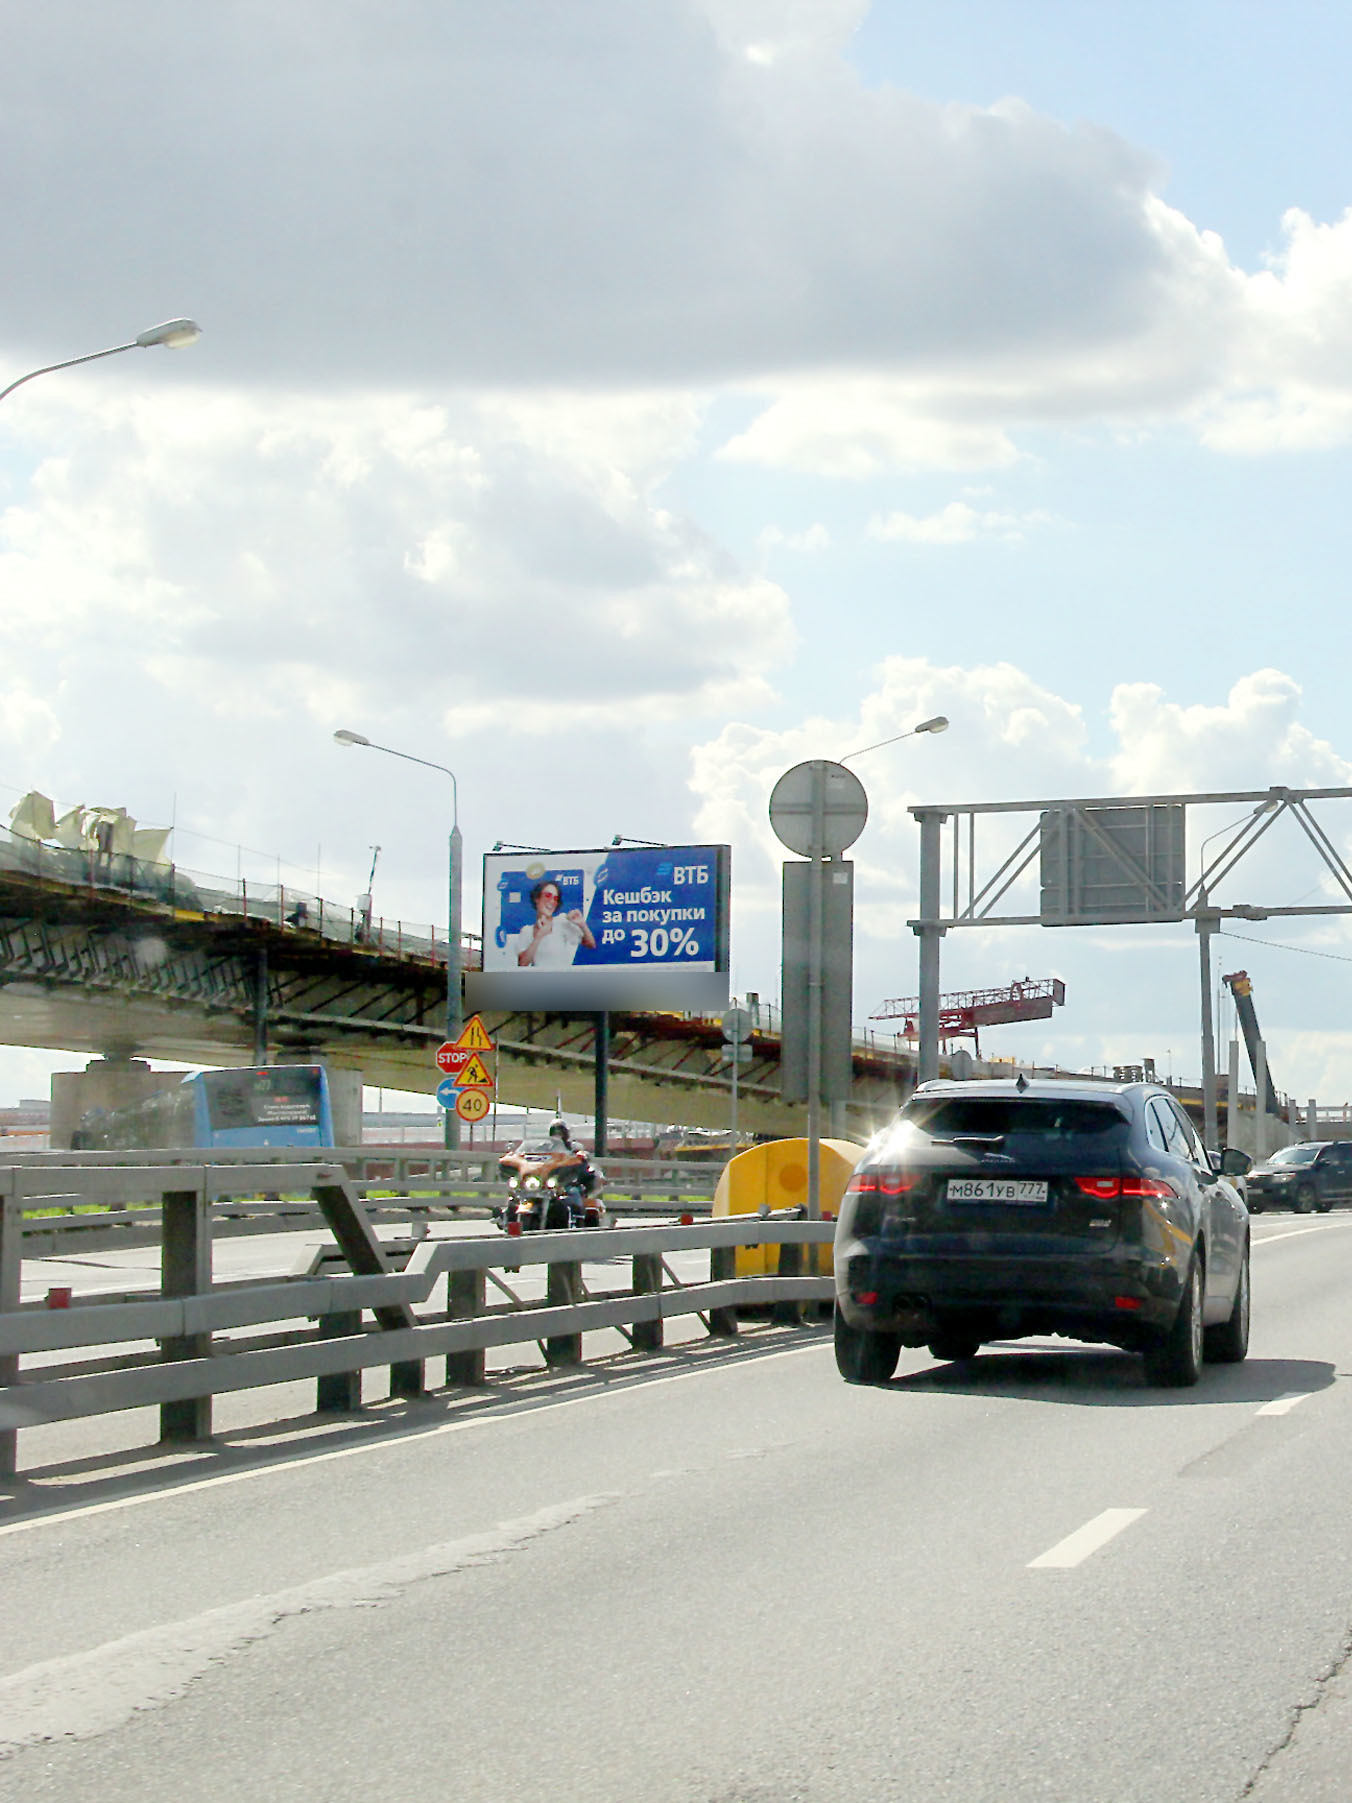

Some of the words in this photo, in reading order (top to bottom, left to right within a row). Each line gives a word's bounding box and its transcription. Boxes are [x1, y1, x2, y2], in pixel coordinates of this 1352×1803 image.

[563, 876, 579, 886] ВТБ
[673, 865, 709, 885] ВТБ
[603, 886, 672, 905] Кешбэк
[602, 910, 622, 923] за
[626, 908, 705, 925] покупки
[602, 929, 625, 944] до
[630, 927, 699, 957] 30%
[438, 1052, 467, 1063] STOP
[462, 1098, 482, 1111] 40
